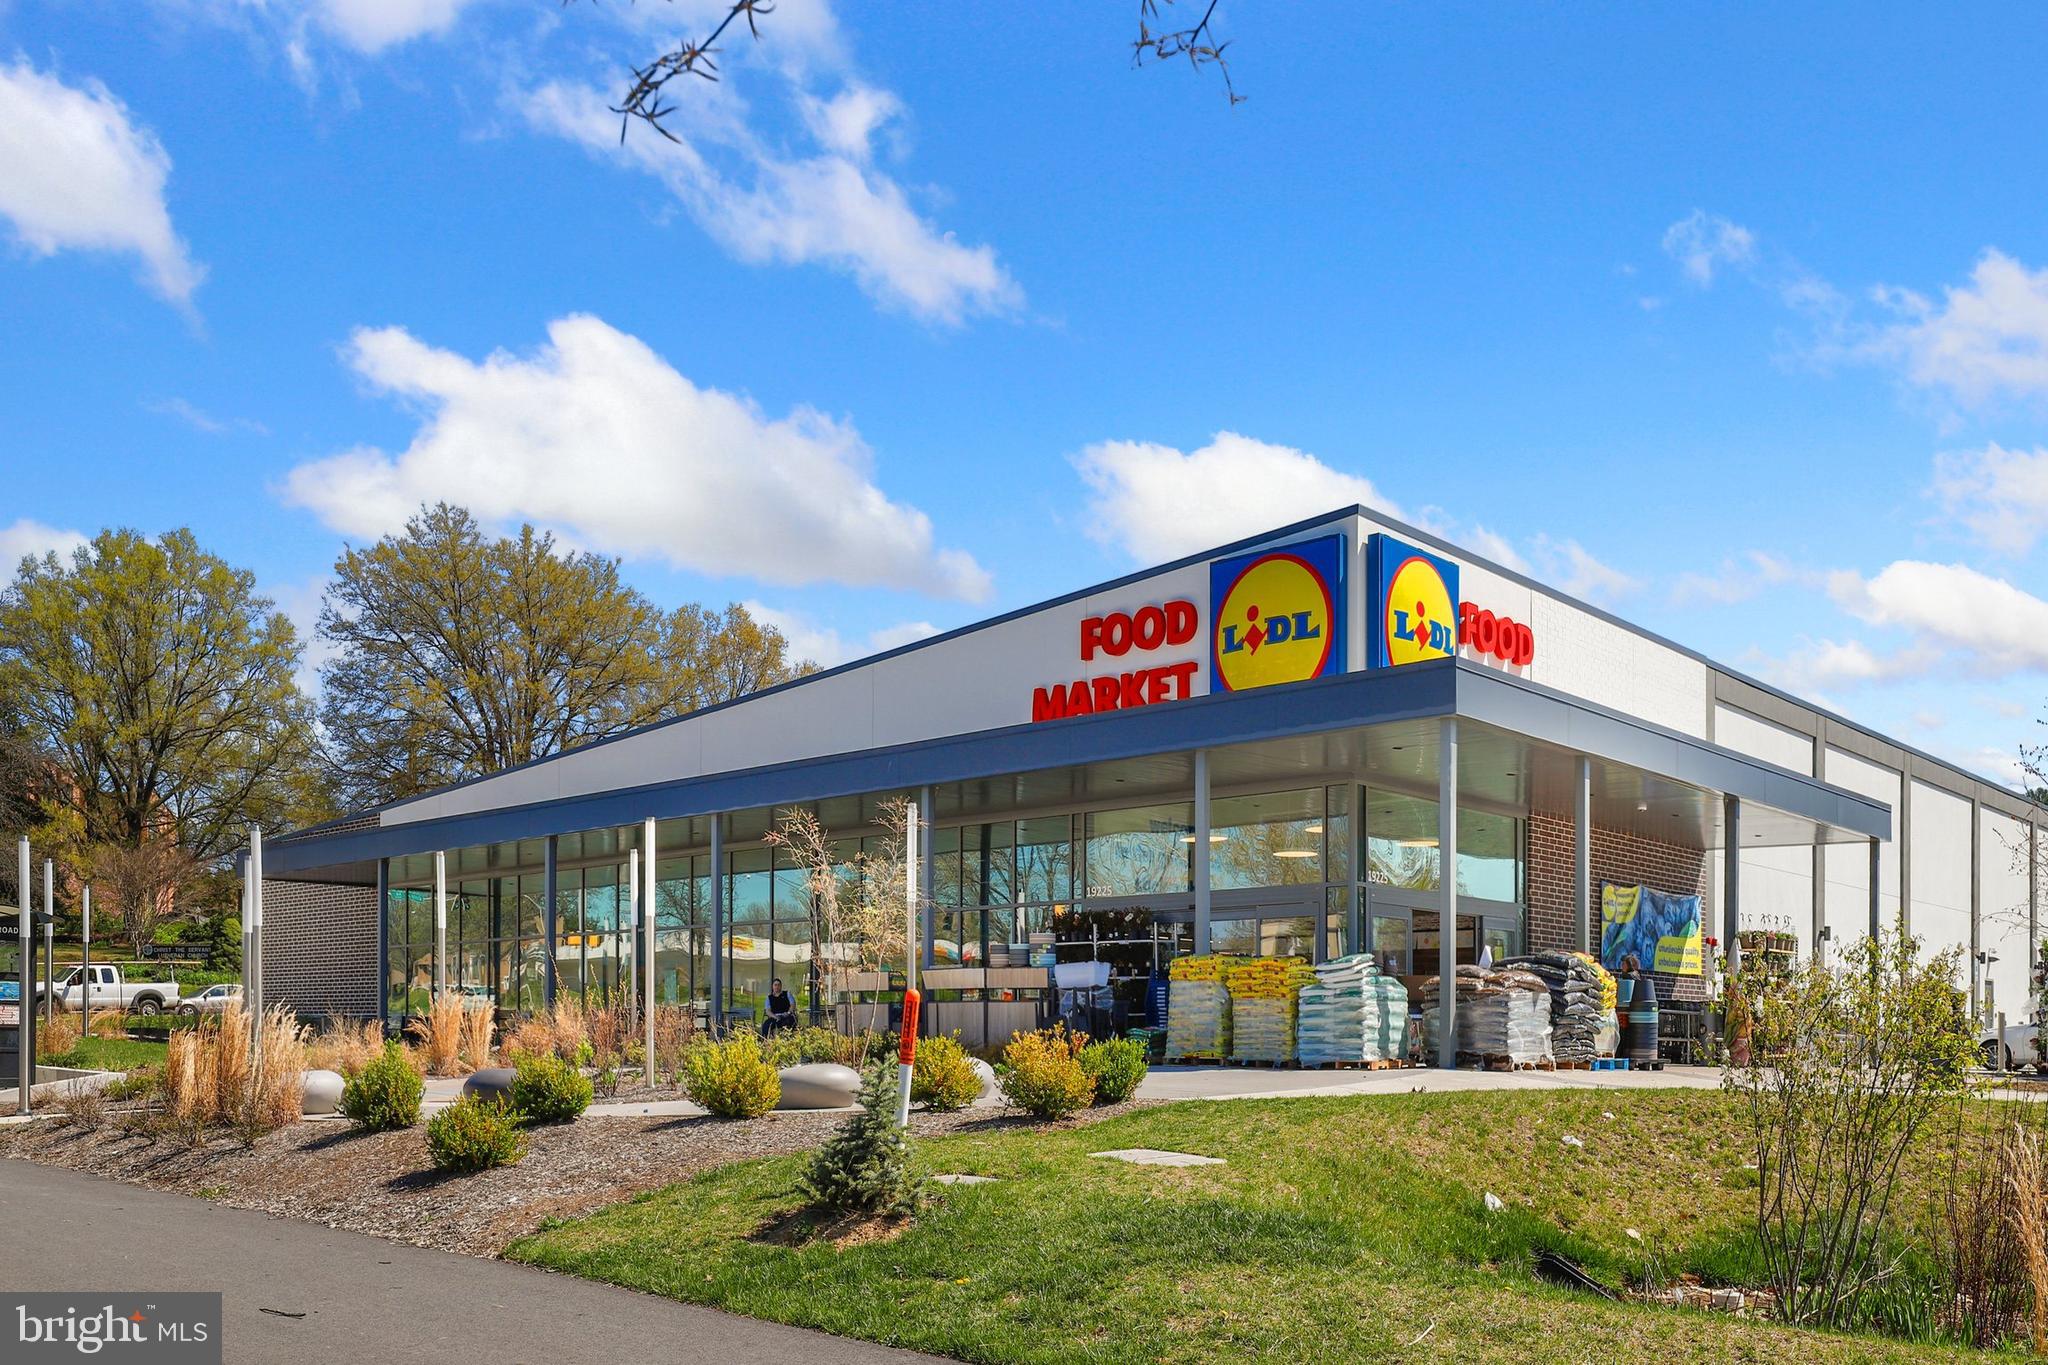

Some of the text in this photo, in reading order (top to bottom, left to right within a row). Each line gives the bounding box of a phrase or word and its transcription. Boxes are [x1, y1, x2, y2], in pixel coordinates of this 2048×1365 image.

[1081, 601, 1198, 661] FOOD
[1459, 602, 1534, 666] FOOD
[1033, 662, 1198, 722] MARKET
[1087, 886, 1112, 897] 19225
